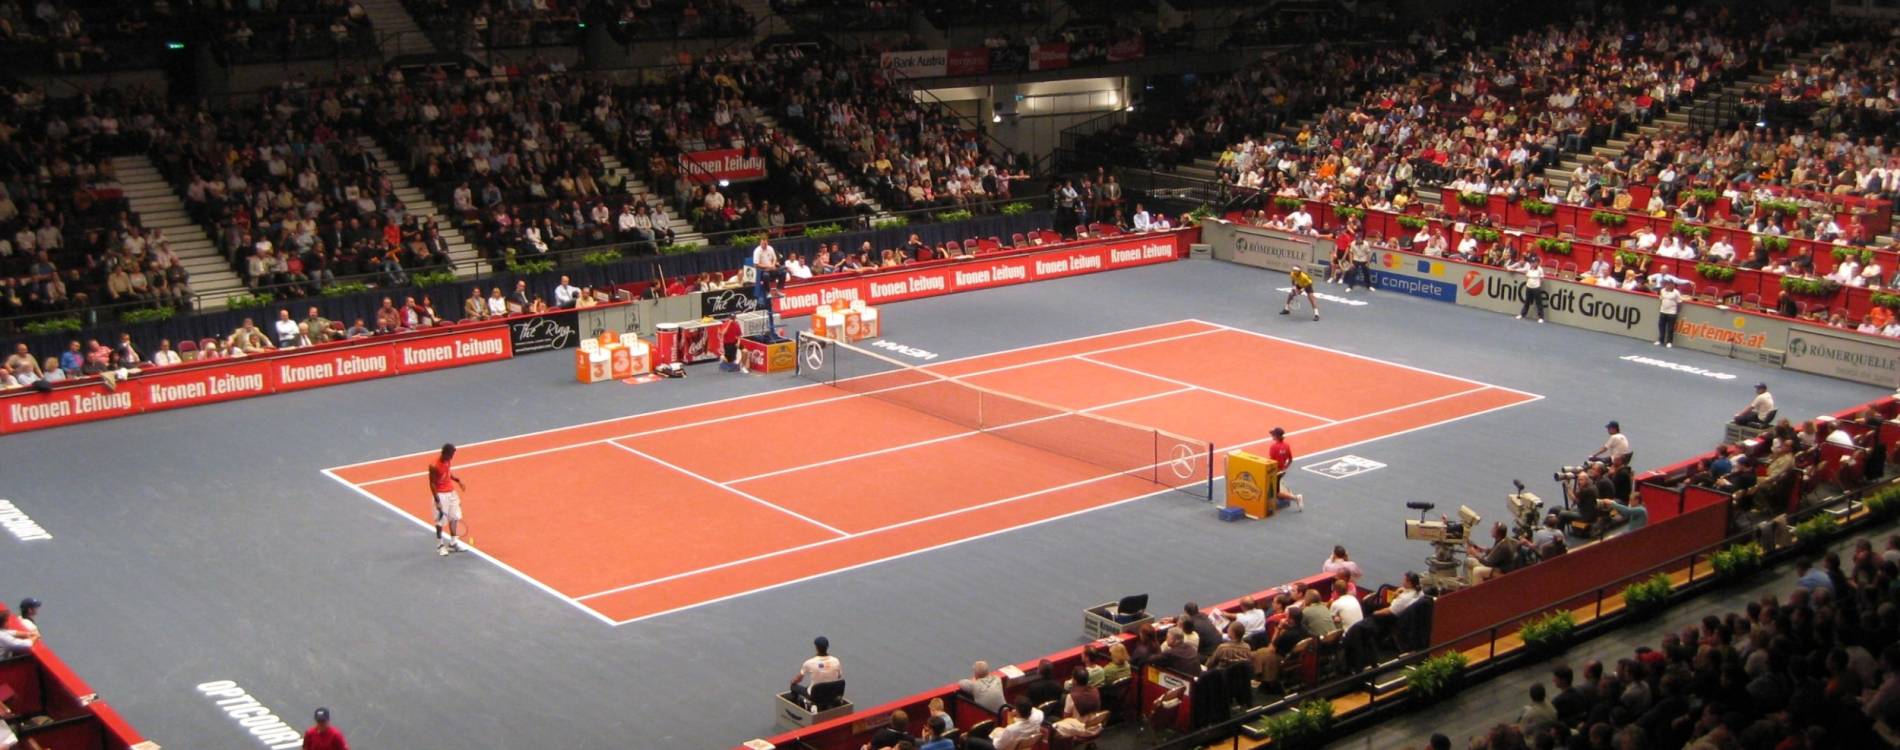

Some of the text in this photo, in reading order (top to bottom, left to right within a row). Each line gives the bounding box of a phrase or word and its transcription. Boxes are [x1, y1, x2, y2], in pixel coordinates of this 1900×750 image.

[893, 56, 916, 68] Bank
[917, 54, 946, 66] Austria
[724, 154, 763, 171] Zeitung
[1035, 254, 1101, 276] Kronen Zeitung
[1110, 243, 1172, 264] Kronen Zeitung
[955, 263, 1025, 286] Kronen Zeitung
[1381, 276, 1442, 296] complete
[780, 286, 859, 311] Kronen Zeitung
[870, 275, 945, 299] Kronen Zeitung
[707, 290, 734, 313] The
[1579, 292, 1641, 330] Group
[513, 318, 543, 340] The
[543, 320, 576, 349] Ring
[403, 344, 452, 366] Kronen
[455, 337, 503, 359] Zeitung
[1810, 343, 1896, 371] RÖMERQUELLE
[281, 354, 387, 385] Kronen Zeitung
[593, 363, 605, 378] 3
[151, 371, 263, 403] Kronen Zeitung
[11, 390, 131, 424] Kronen Zeitung
[196, 680, 304, 750] OPTICOURT
